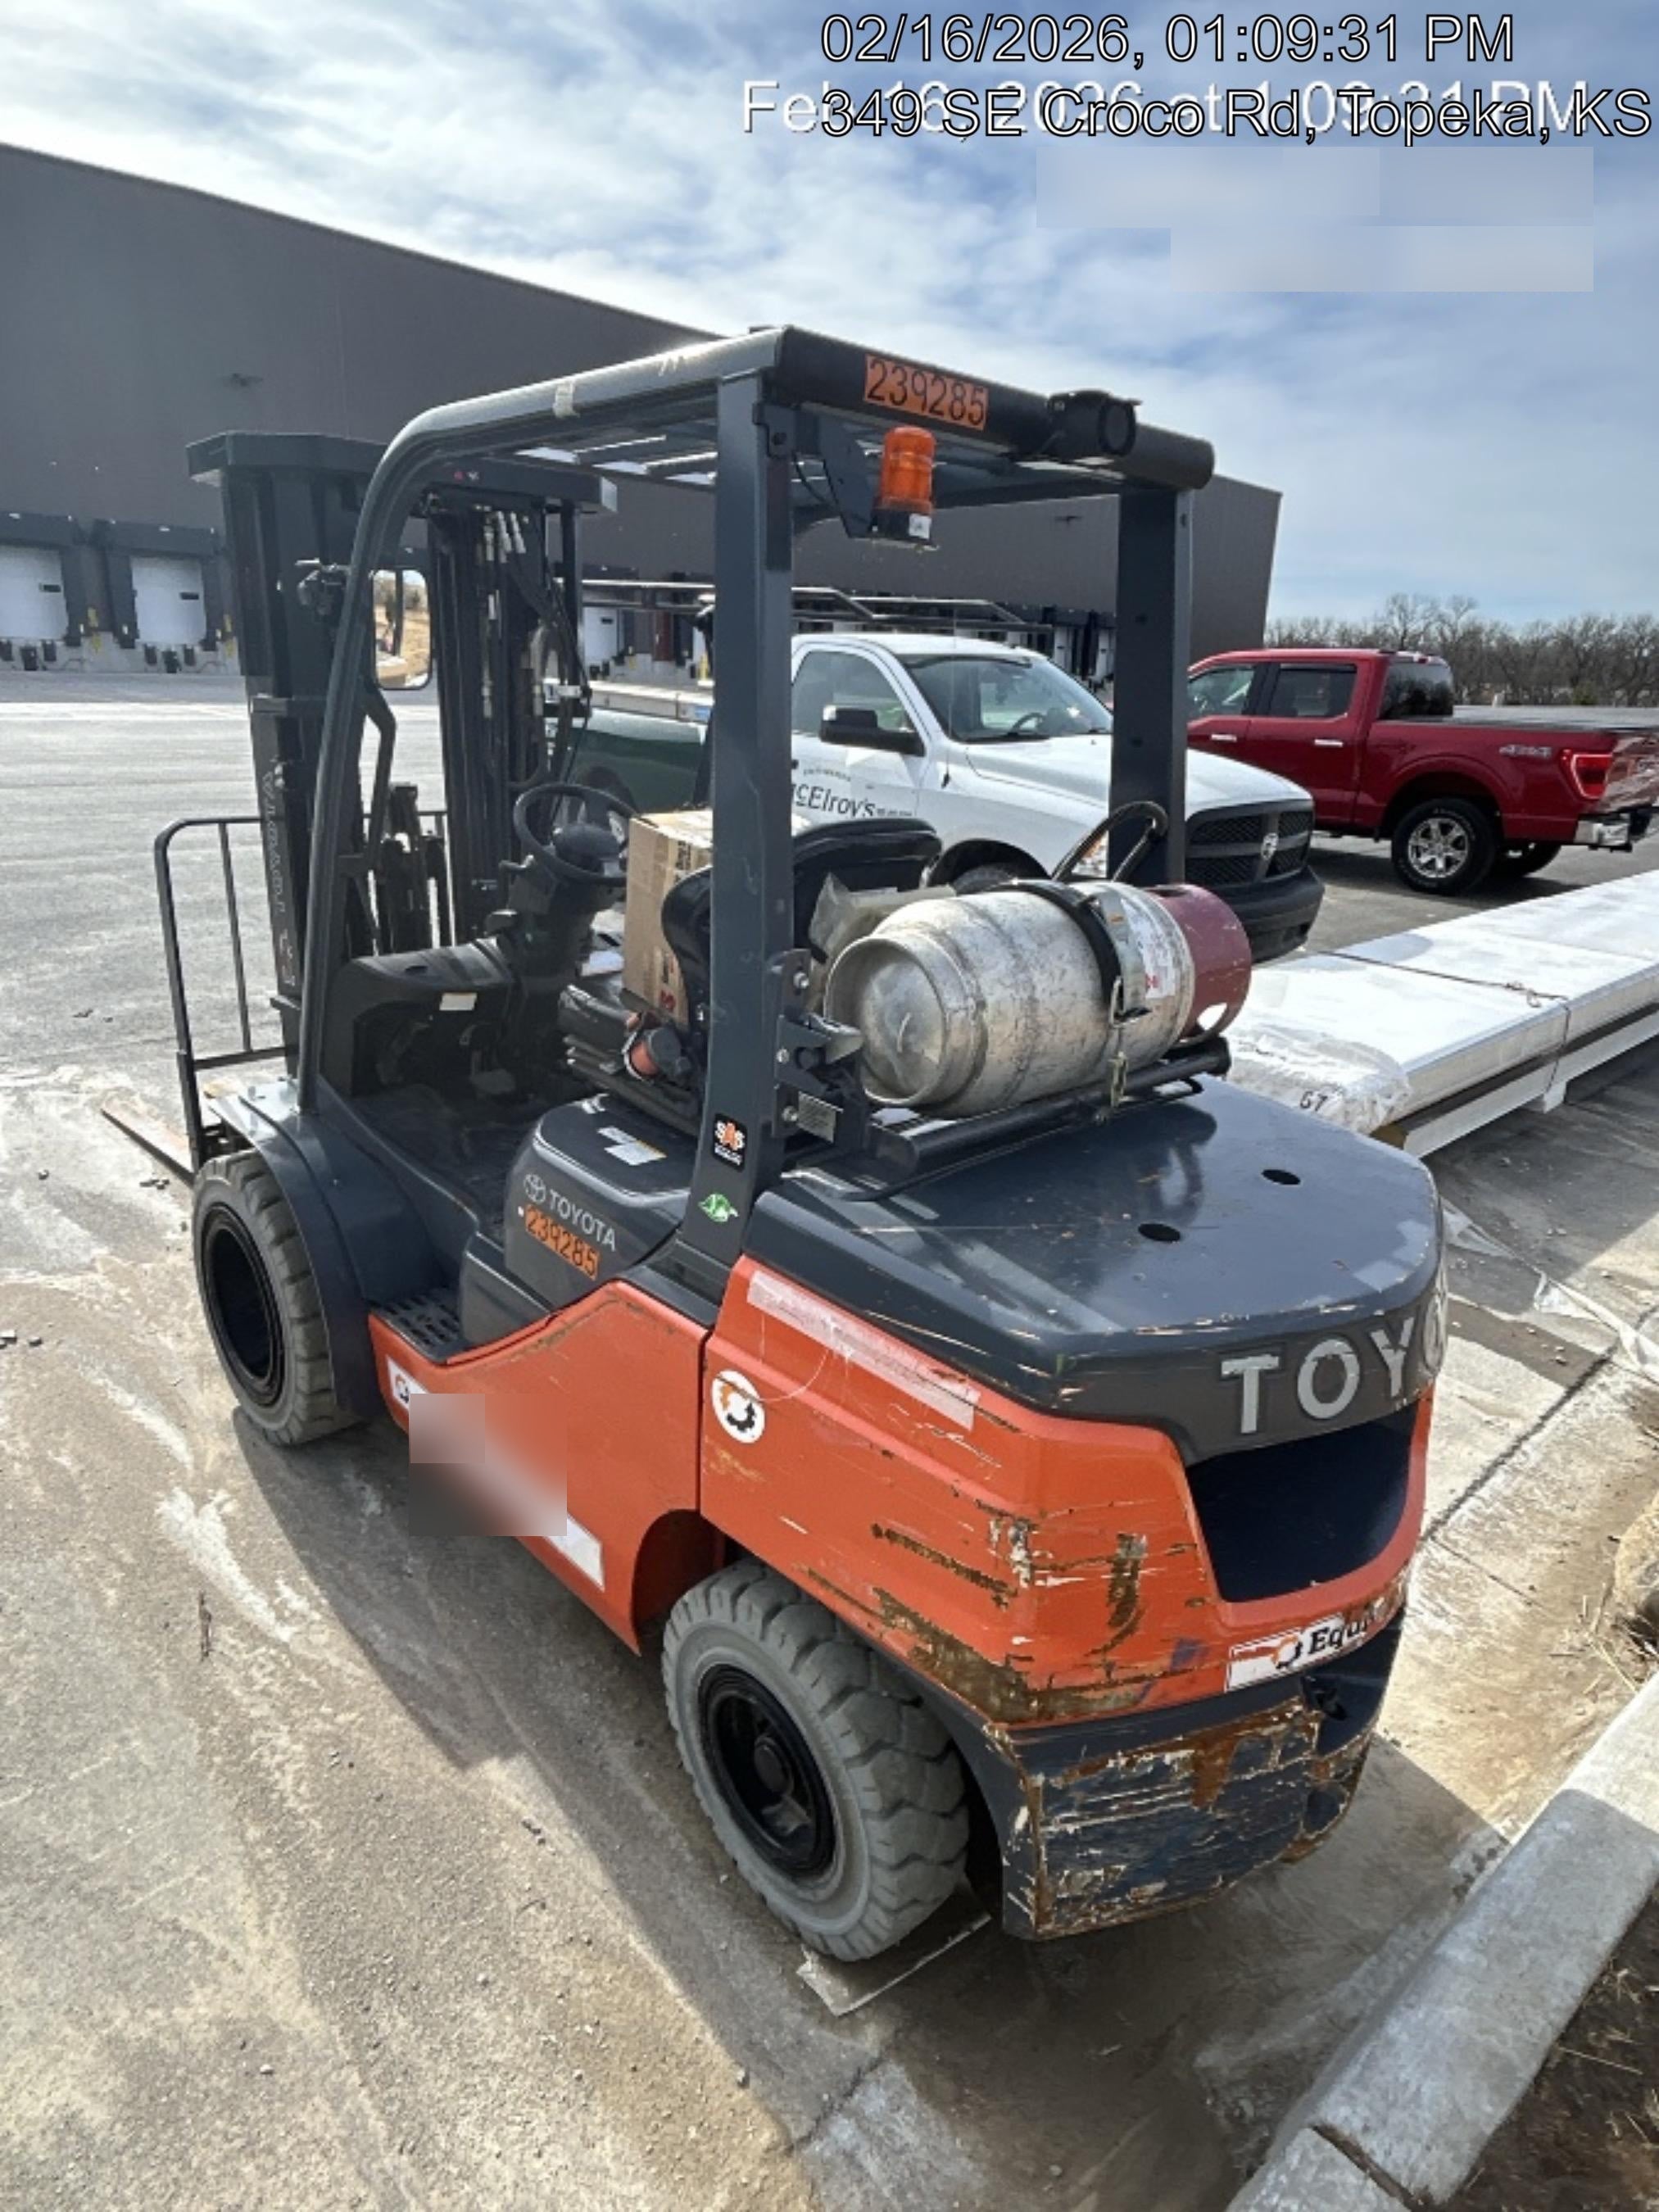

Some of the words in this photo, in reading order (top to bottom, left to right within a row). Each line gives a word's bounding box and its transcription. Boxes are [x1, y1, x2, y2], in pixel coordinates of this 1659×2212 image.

[867, 359, 985, 425] 239285
[791, 783, 876, 817] cElroy's
[527, 1207, 596, 1276] 239285
[550, 1189, 616, 1252] TOYOTA
